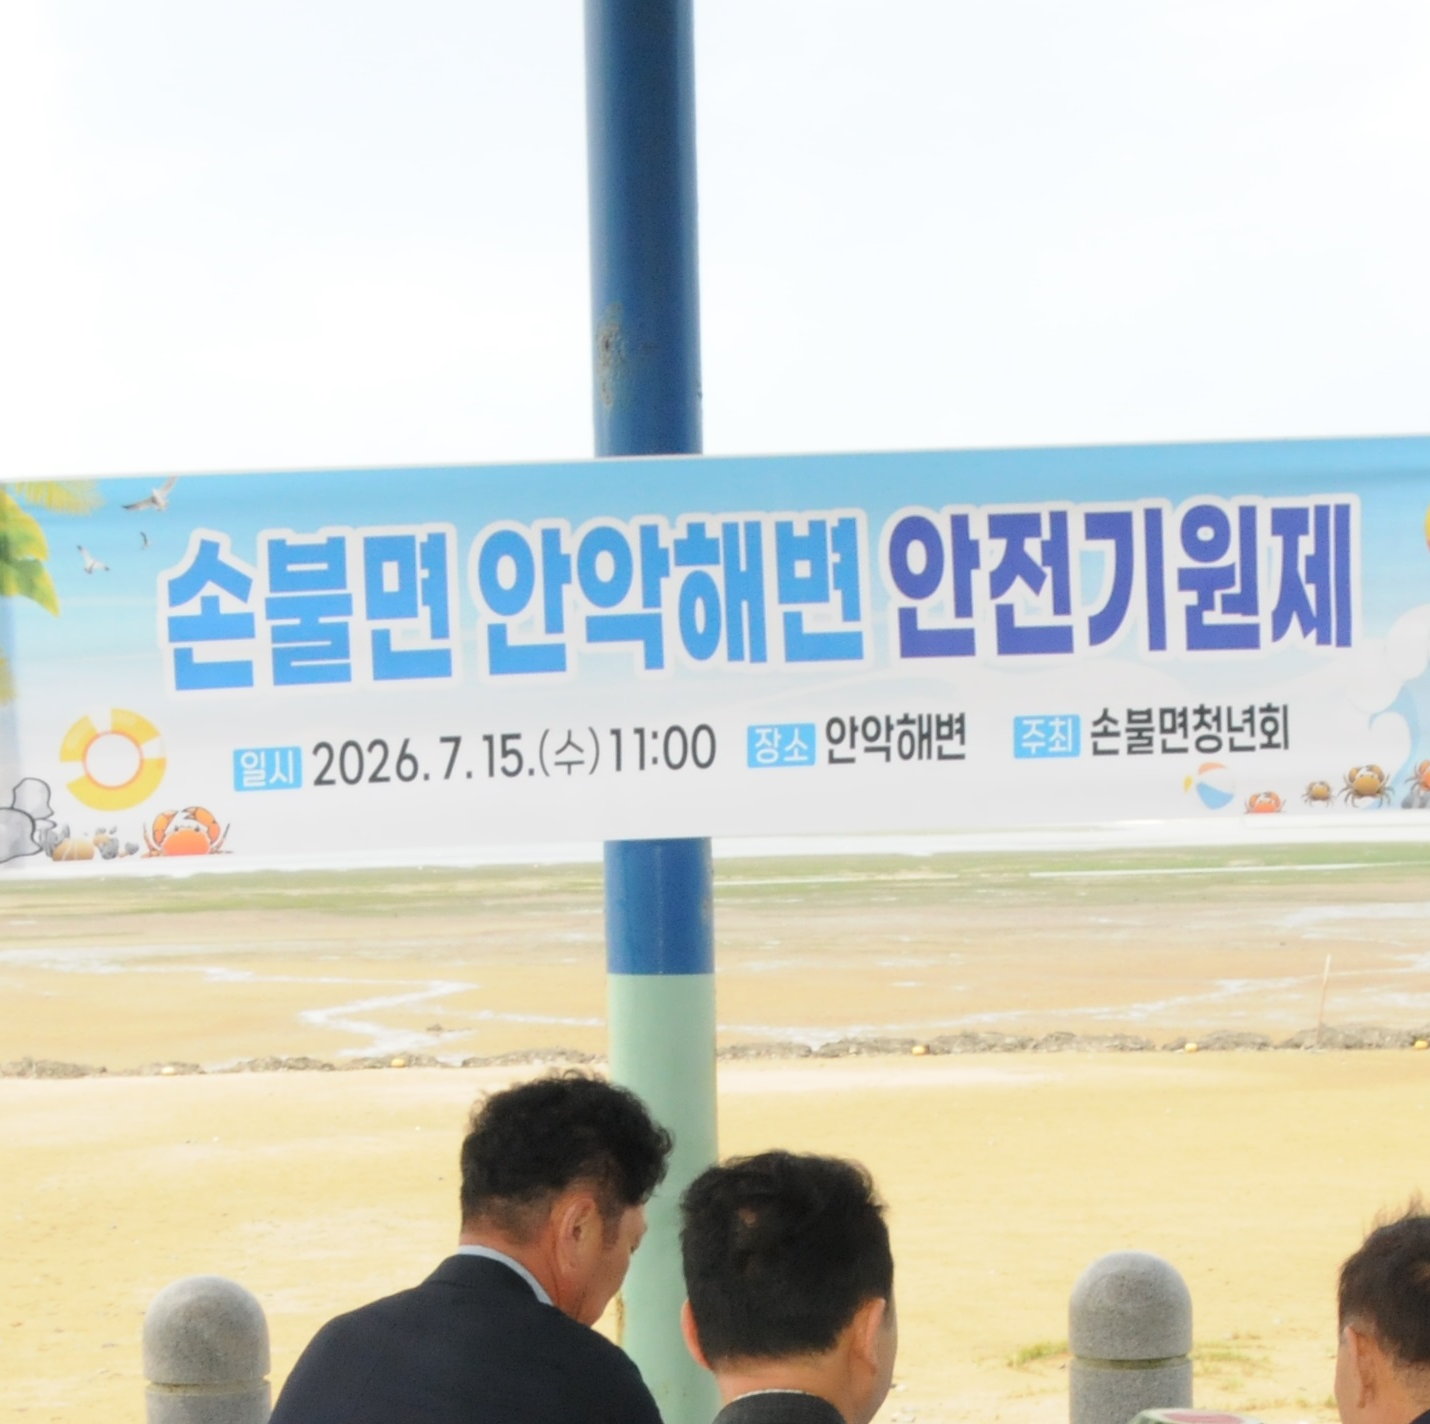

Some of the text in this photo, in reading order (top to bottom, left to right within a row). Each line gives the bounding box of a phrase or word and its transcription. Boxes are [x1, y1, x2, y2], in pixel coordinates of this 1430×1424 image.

[168, 502, 1353, 691] 손불면 안악해변 안전기원제
[238, 751, 296, 789] 일시
[754, 725, 809, 765] 장소
[824, 712, 966, 766] 안악해변
[1020, 716, 1073, 756] 주최
[1090, 703, 1291, 757] 손불면청년회
